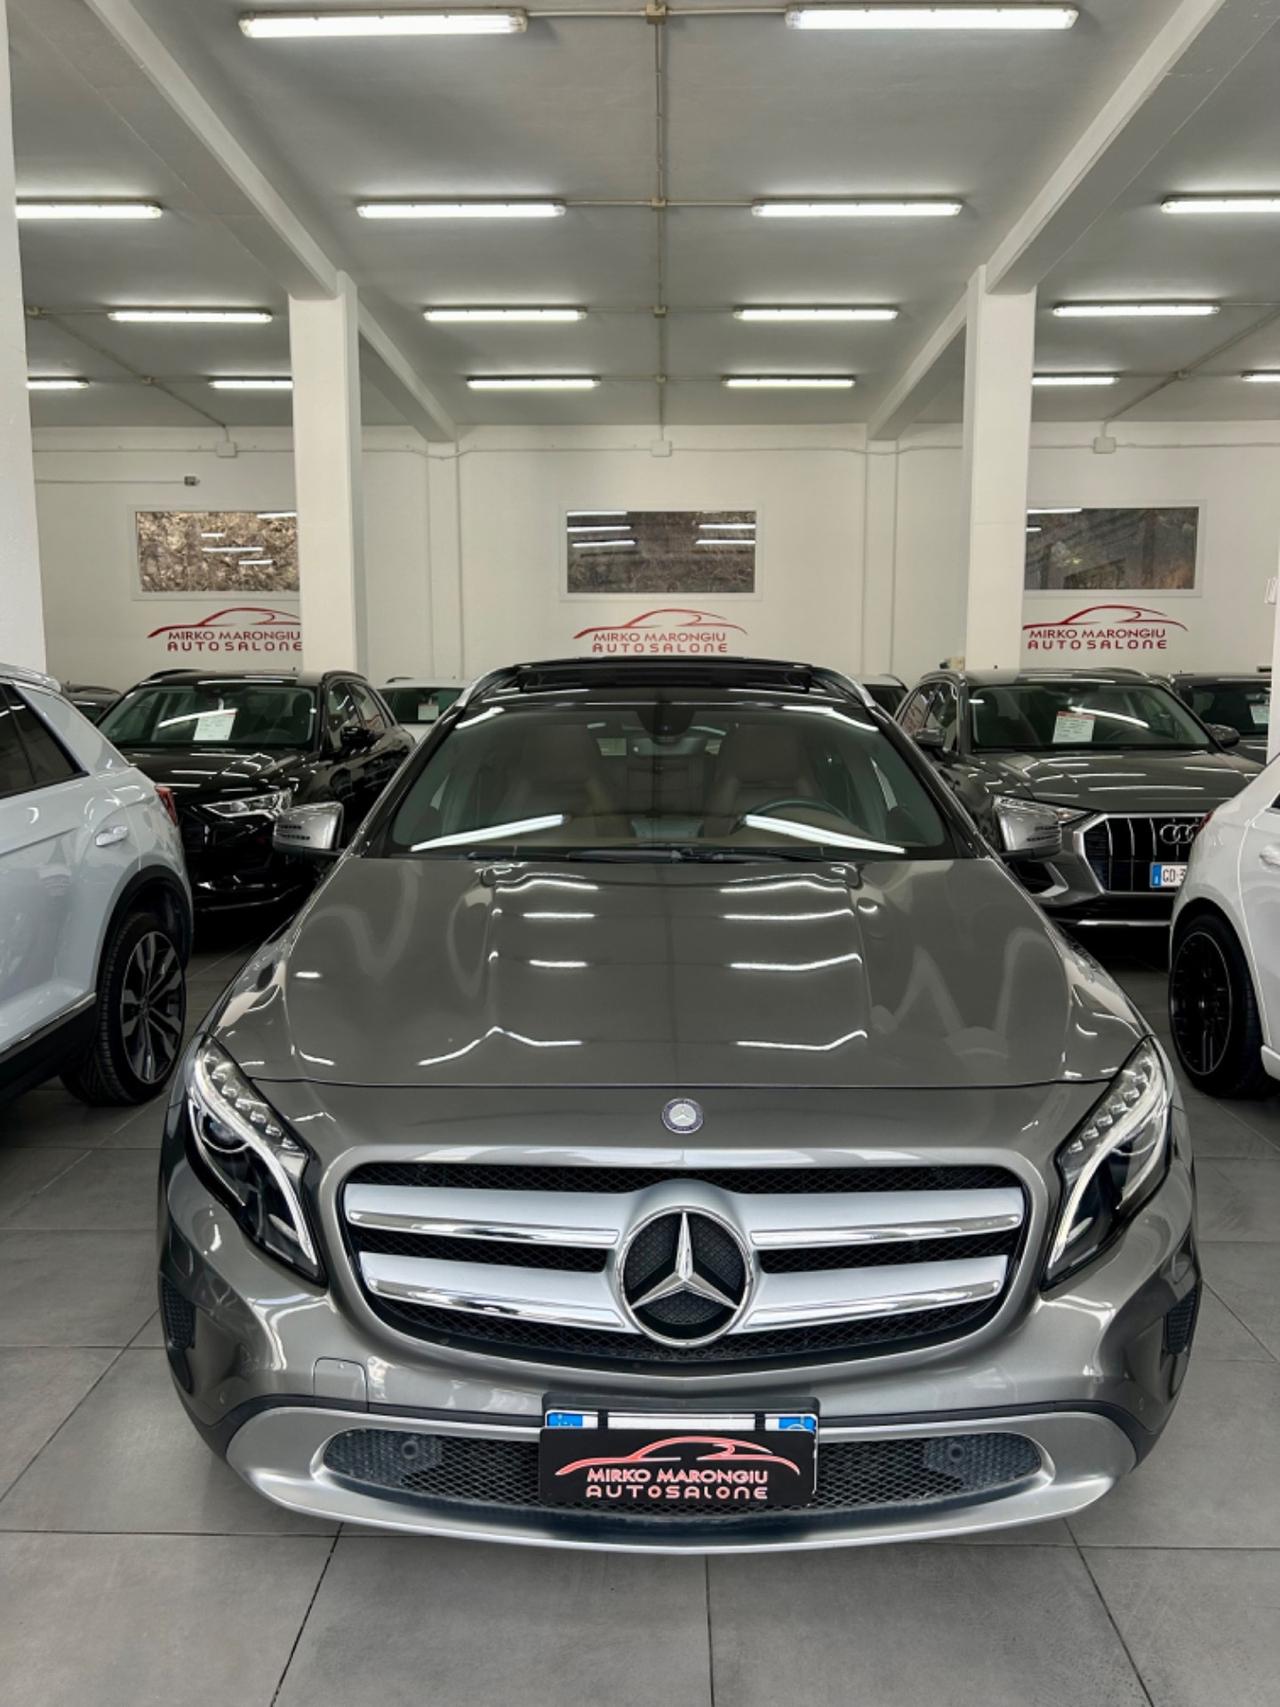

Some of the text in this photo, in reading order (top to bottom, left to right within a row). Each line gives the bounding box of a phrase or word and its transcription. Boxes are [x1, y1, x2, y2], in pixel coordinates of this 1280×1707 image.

[168, 631, 301, 641] MIRKO MARONGIU
[593, 632, 726, 642] MIRKO MARONGIU
[1029, 628, 1166, 639] MIRKO MARONGIU
[167, 641, 303, 651] AUTOSALONE
[592, 643, 728, 653] AUTOSALONE
[1027, 639, 1168, 650] AUTOSALONE
[586, 1467, 769, 1484] MIRKO MARONGIU
[585, 1485, 769, 1500] AUTOSALONE
